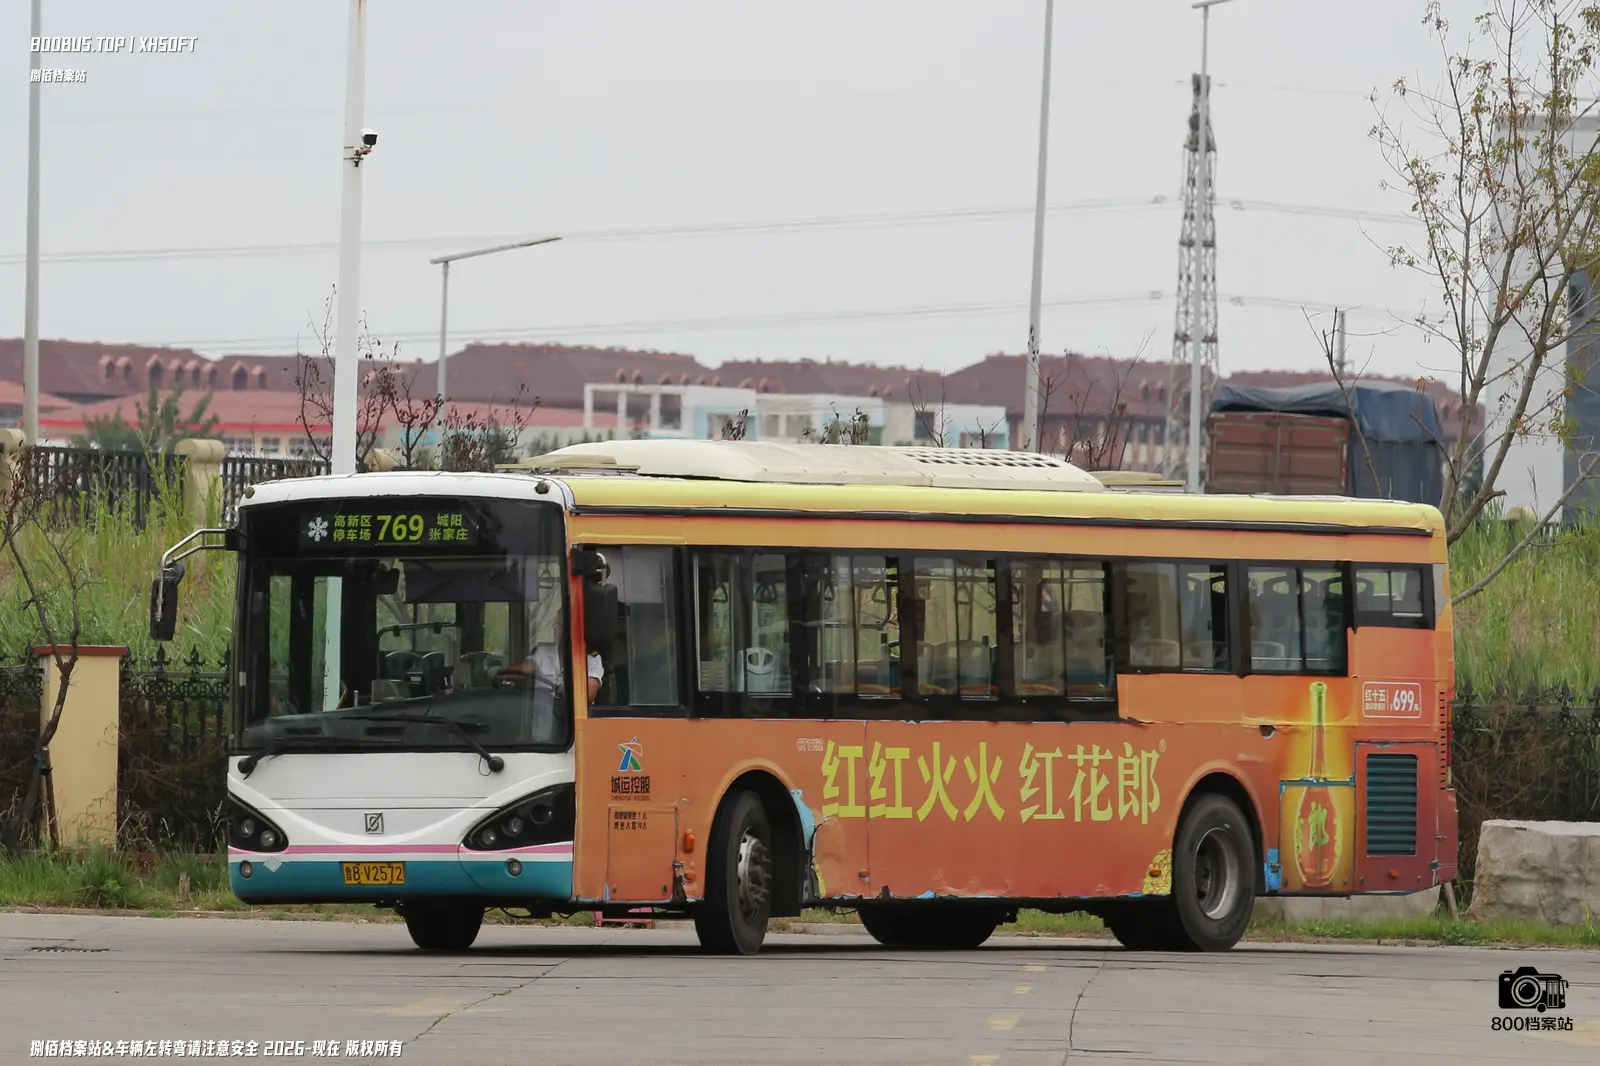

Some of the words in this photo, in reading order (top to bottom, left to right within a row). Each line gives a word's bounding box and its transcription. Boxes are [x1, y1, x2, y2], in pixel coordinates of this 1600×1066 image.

[334, 514, 373, 528] 高新区
[437, 513, 463, 527] 城阳
[333, 528, 372, 541] 停车场
[376, 514, 424, 541] 769
[429, 527, 469, 541] 张家庄
[611, 776, 651, 794] 城运控股
[821, 739, 1006, 823] 红红火火
[1018, 741, 1161, 825] 红花郎
